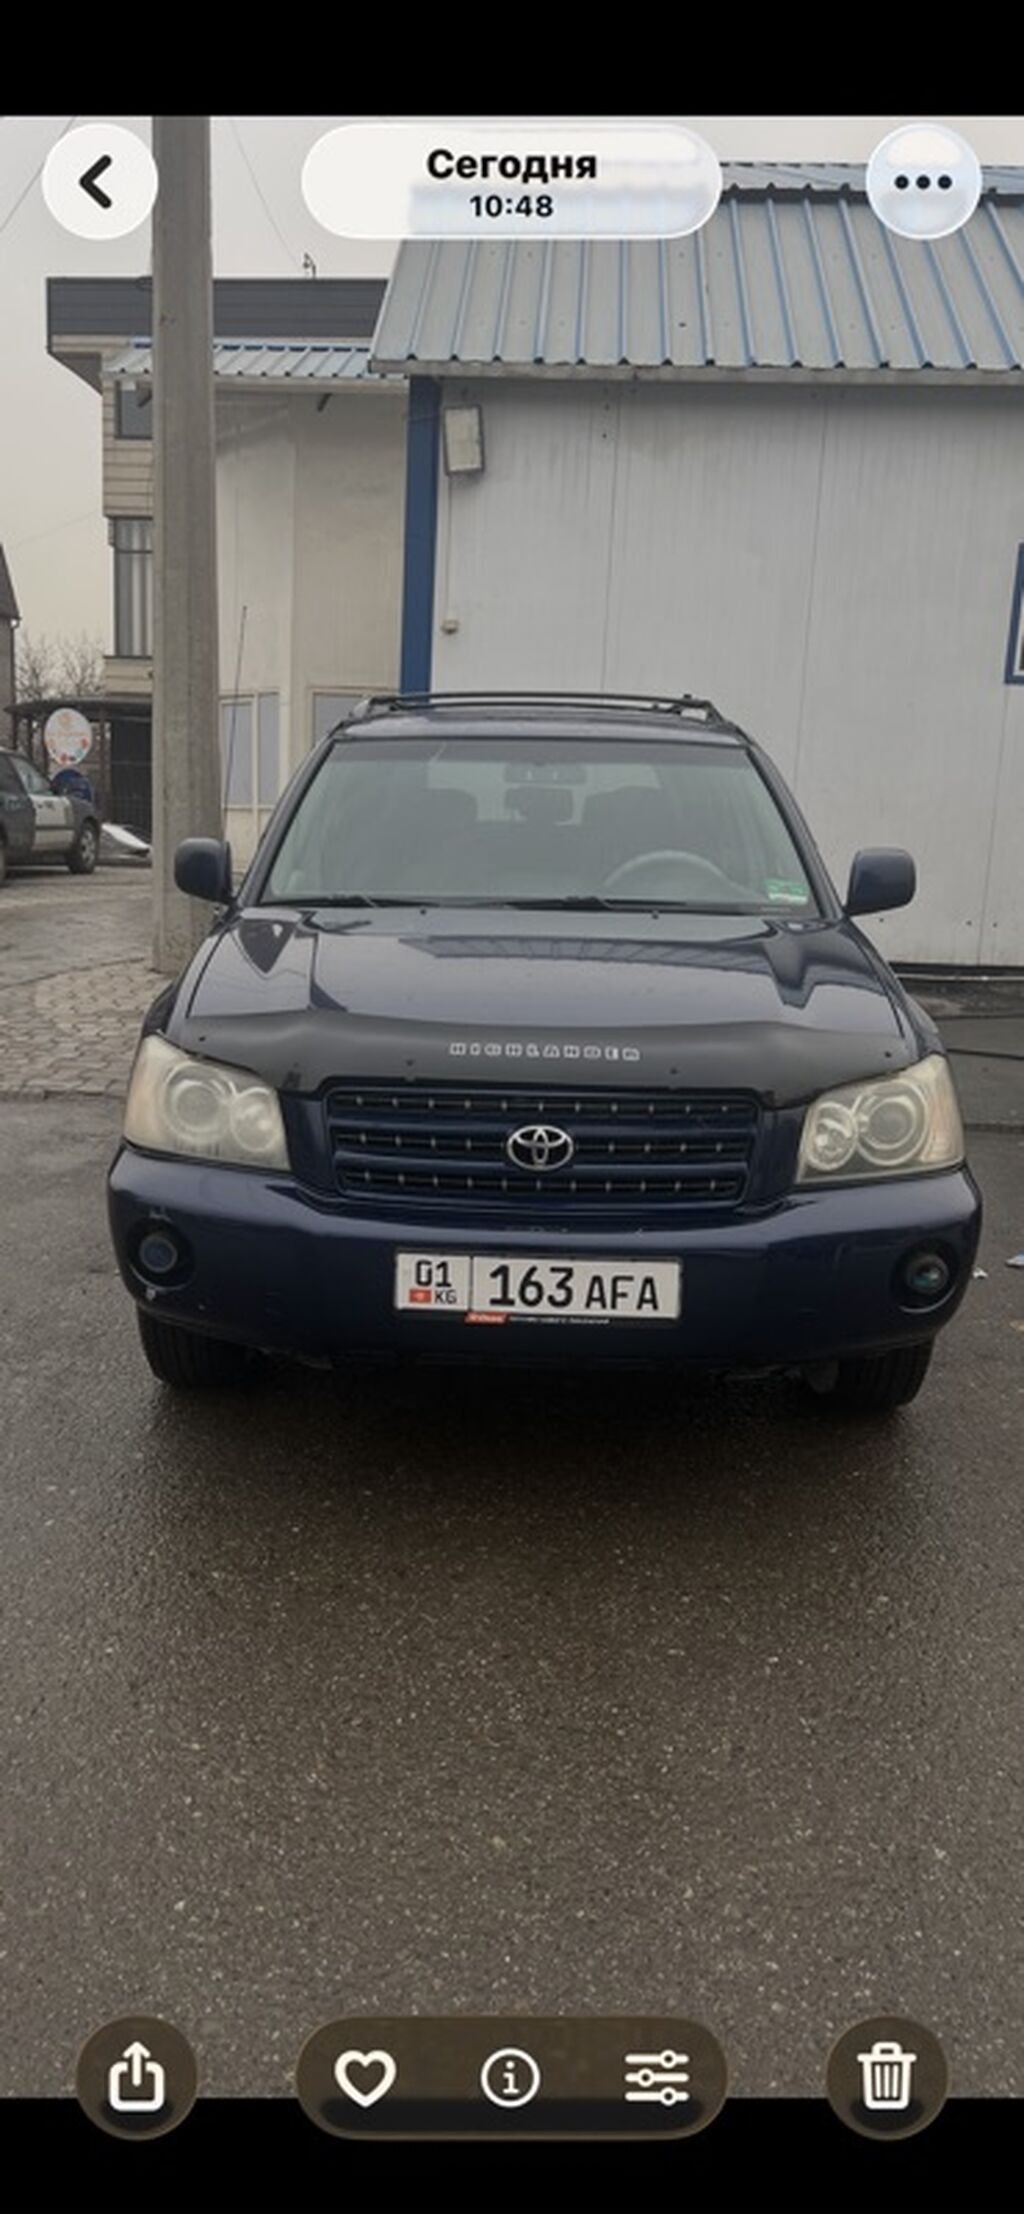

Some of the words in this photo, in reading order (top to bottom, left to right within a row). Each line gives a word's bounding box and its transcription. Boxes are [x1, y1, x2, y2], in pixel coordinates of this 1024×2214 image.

[449, 1042, 640, 1061] HIGHLANDER
[415, 1260, 452, 1288] 01
[489, 1265, 575, 1308] 163
[585, 1275, 659, 1311] AFA
[434, 1289, 457, 1304] KG
